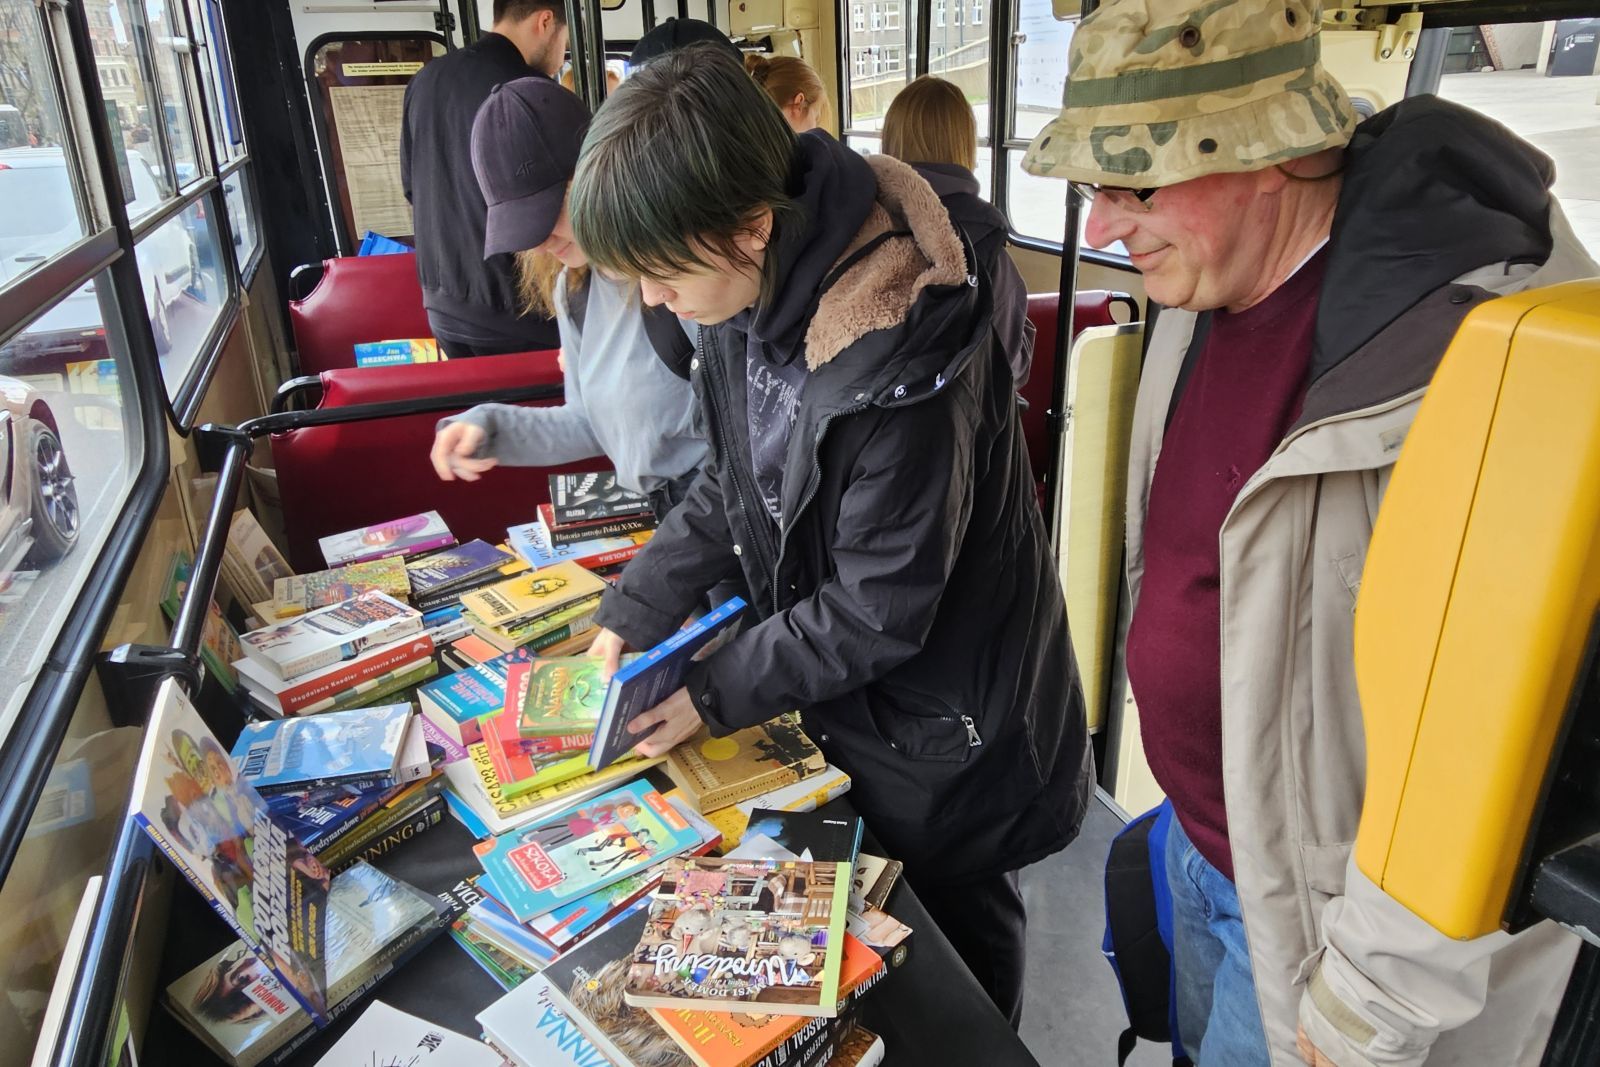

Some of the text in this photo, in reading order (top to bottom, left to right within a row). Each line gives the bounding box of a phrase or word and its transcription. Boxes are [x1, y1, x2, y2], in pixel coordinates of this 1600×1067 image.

[361, 353, 407, 364] BRZECHWA
[555, 530, 580, 541] Historia
[581, 528, 602, 537] ustroju
[602, 523, 620, 533] Polski
[598, 551, 624, 562] POLSKA
[289, 653, 408, 702] Magdalena Knedler Historia Adeli
[450, 682, 480, 704] LIANE
[455, 672, 500, 707] MORIARTY
[542, 666, 569, 718] NARNIA
[524, 846, 555, 883] SZKOŁA
[270, 823, 291, 965] RODZINKA
[648, 943, 798, 986] Urodziny
[252, 981, 289, 1014] PROMOCJA
[680, 976, 767, 996] MYSI DOMEK
[788, 1012, 829, 1049] PASCAL
[797, 1030, 832, 1063] PRZEPISY
